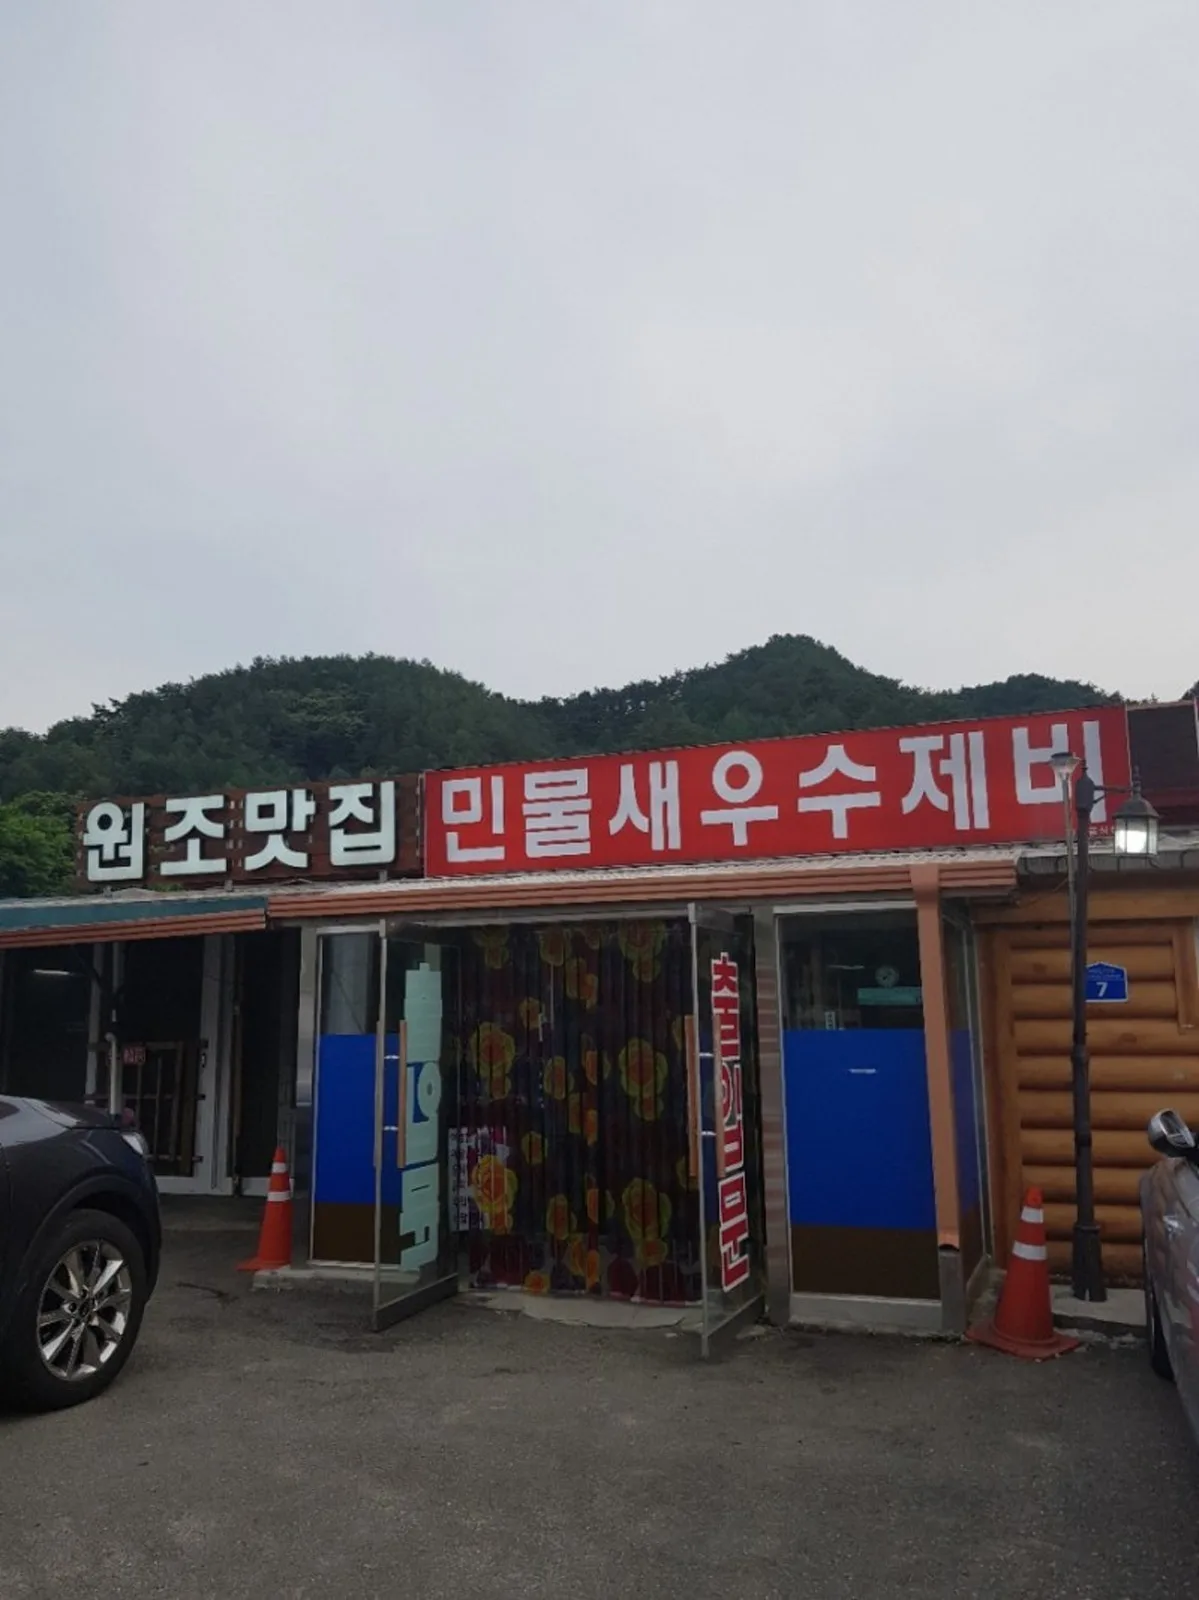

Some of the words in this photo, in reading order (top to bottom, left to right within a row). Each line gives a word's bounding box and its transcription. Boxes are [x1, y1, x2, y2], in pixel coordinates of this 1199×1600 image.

[441, 720, 1107, 864] 민물새우수제비
[1095, 981, 1109, 998] 7
[711, 952, 750, 1292] 출입문
